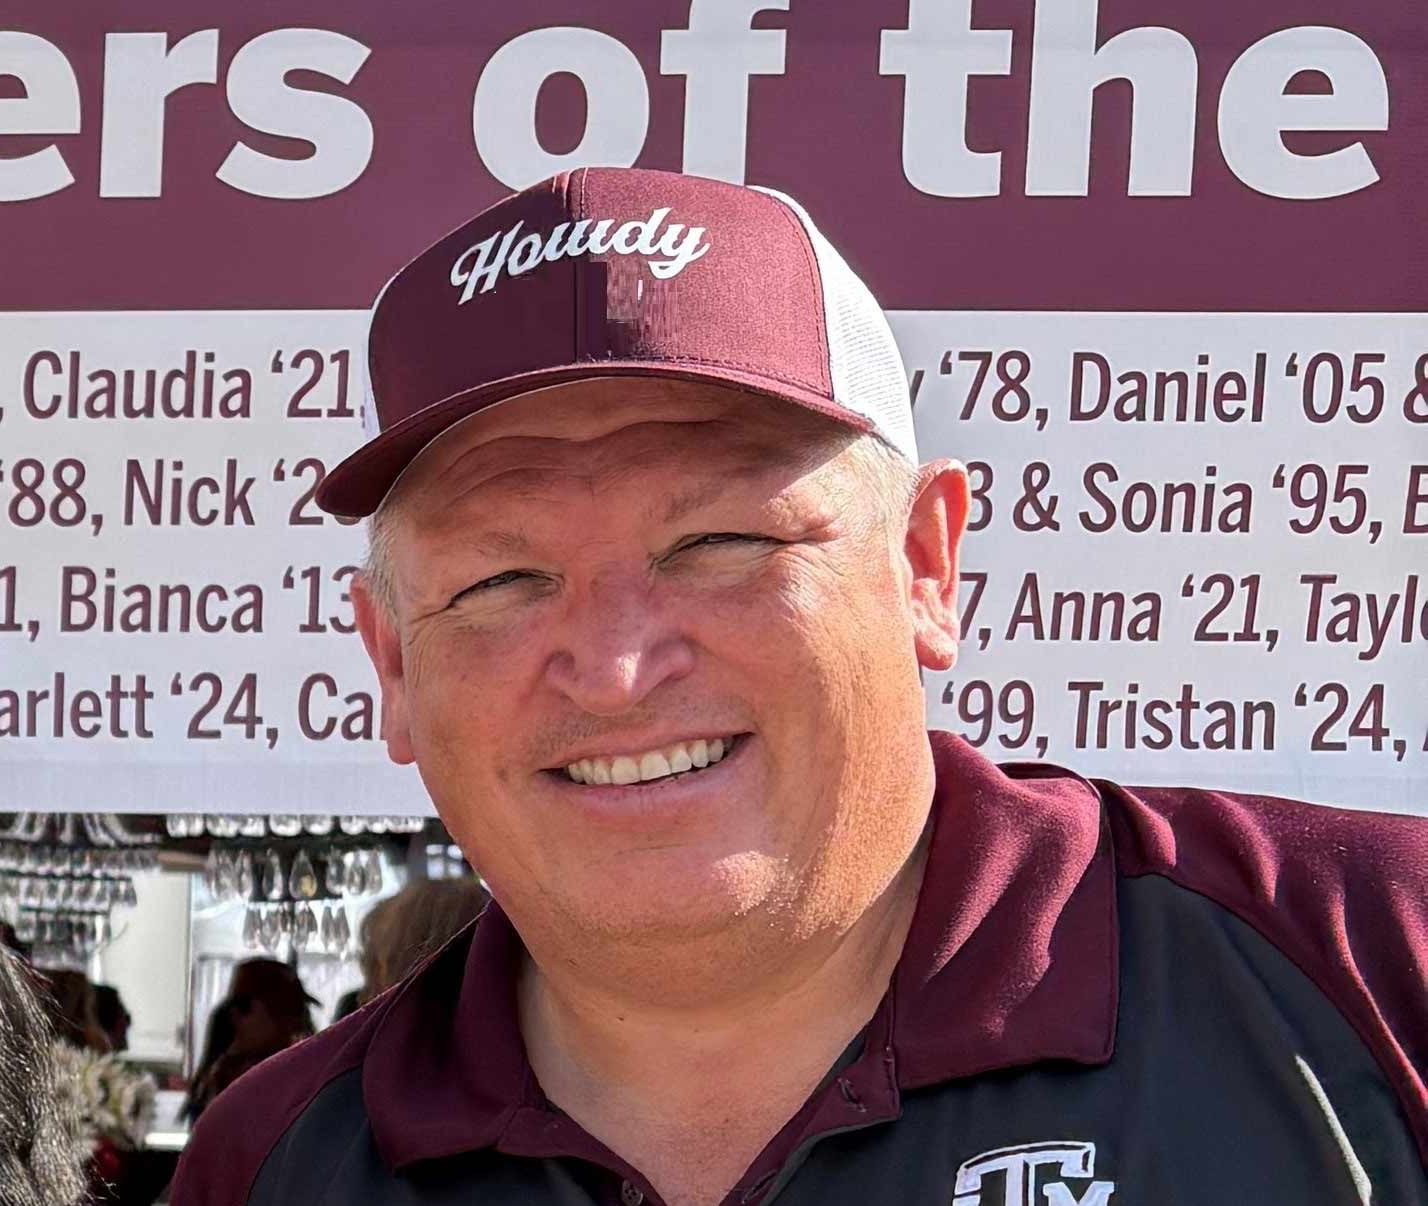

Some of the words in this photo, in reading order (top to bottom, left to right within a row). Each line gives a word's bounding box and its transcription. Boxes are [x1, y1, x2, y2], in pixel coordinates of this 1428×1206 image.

[473, 0, 789, 198] of
[879, 0, 1390, 200] the
[450, 206, 710, 306] Howdy
[24, 350, 251, 420] Claudia
[1070, 352, 1266, 423] Daniel
[1286, 352, 1385, 424] ‘05
[125, 458, 255, 527] Nick
[274, 457, 361, 526] ‘2
[1013, 461, 1060, 532] &
[1079, 462, 1252, 534] Sonia
[1273, 463, 1383, 545] ‘95,
[61, 565, 263, 633] Bianca
[1005, 572, 1161, 642] Anna
[1182, 573, 1278, 653] ‘21,
[1301, 574, 1428, 661] Tayl
[171, 672, 278, 750] ‘24,
[299, 672, 386, 741] Ca
[1068, 681, 1276, 751] Tristan
[1295, 682, 1406, 762] ‘24,
